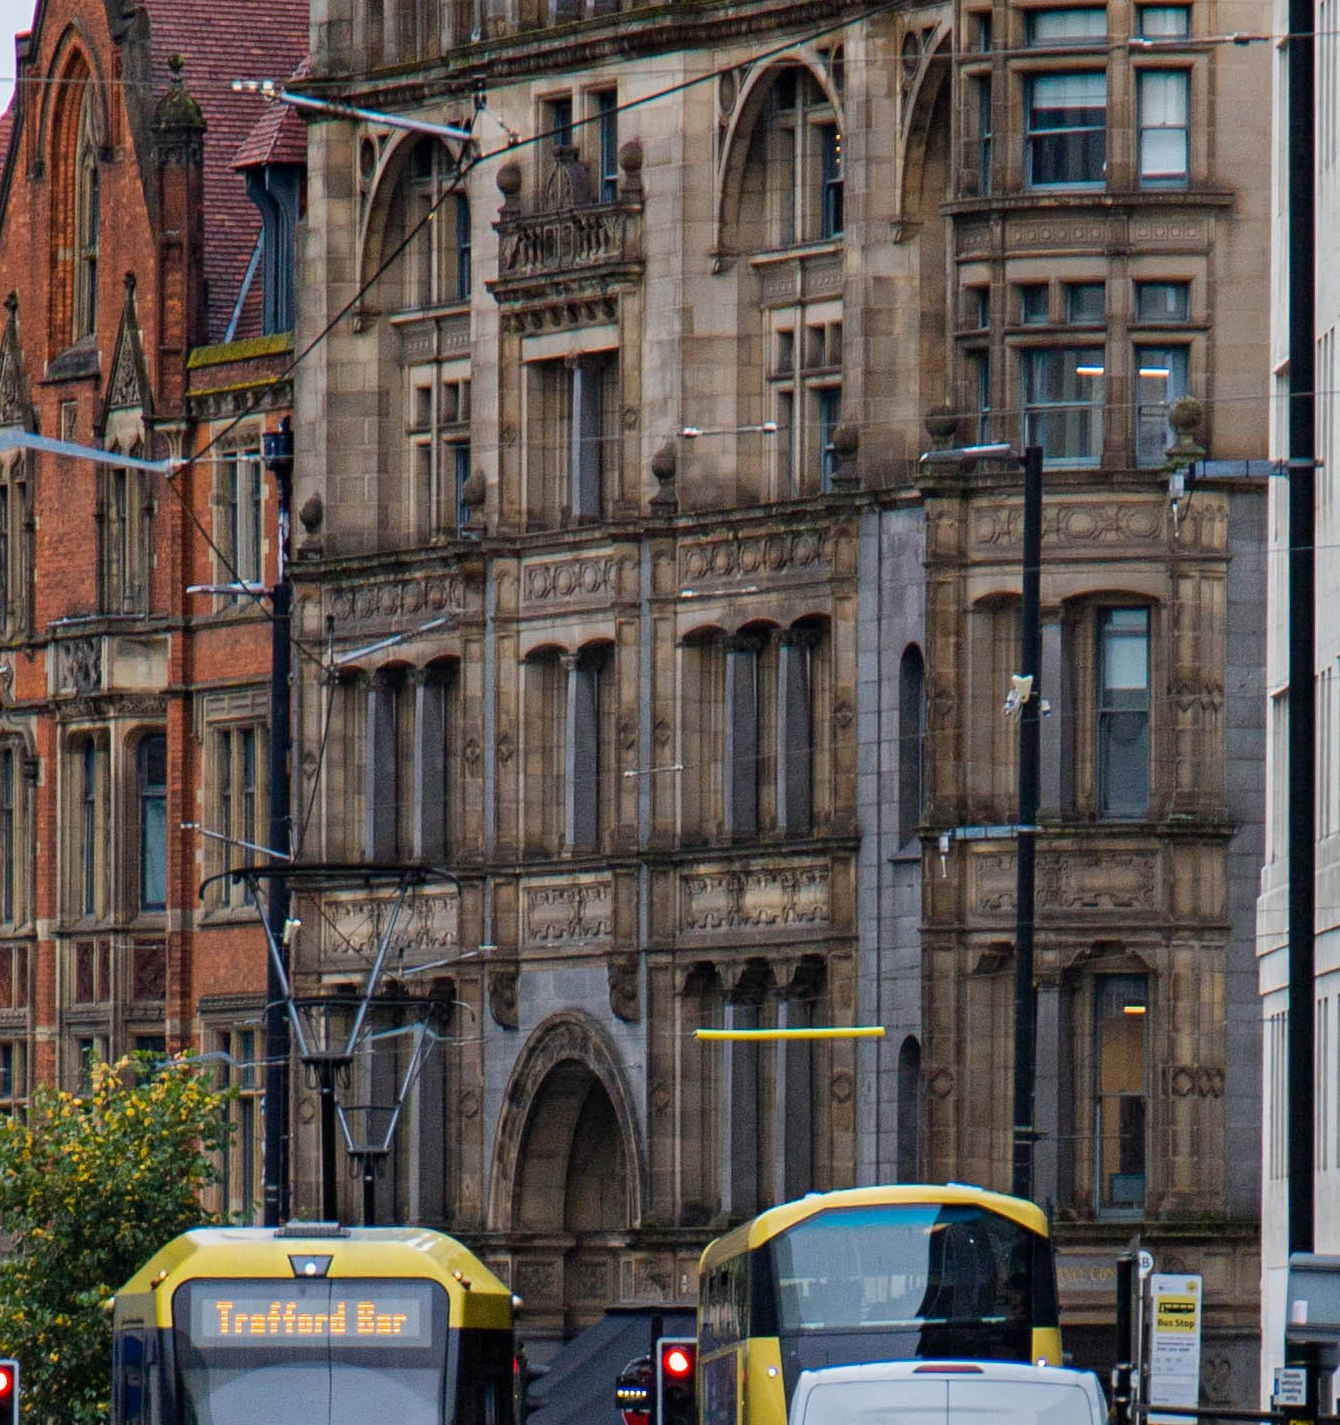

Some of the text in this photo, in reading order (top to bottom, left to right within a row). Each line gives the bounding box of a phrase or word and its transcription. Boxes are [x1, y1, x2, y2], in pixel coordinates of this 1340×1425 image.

[216, 1301, 407, 1334] Trafford Bar
[1157, 1318, 1195, 1330] Bus Stop
